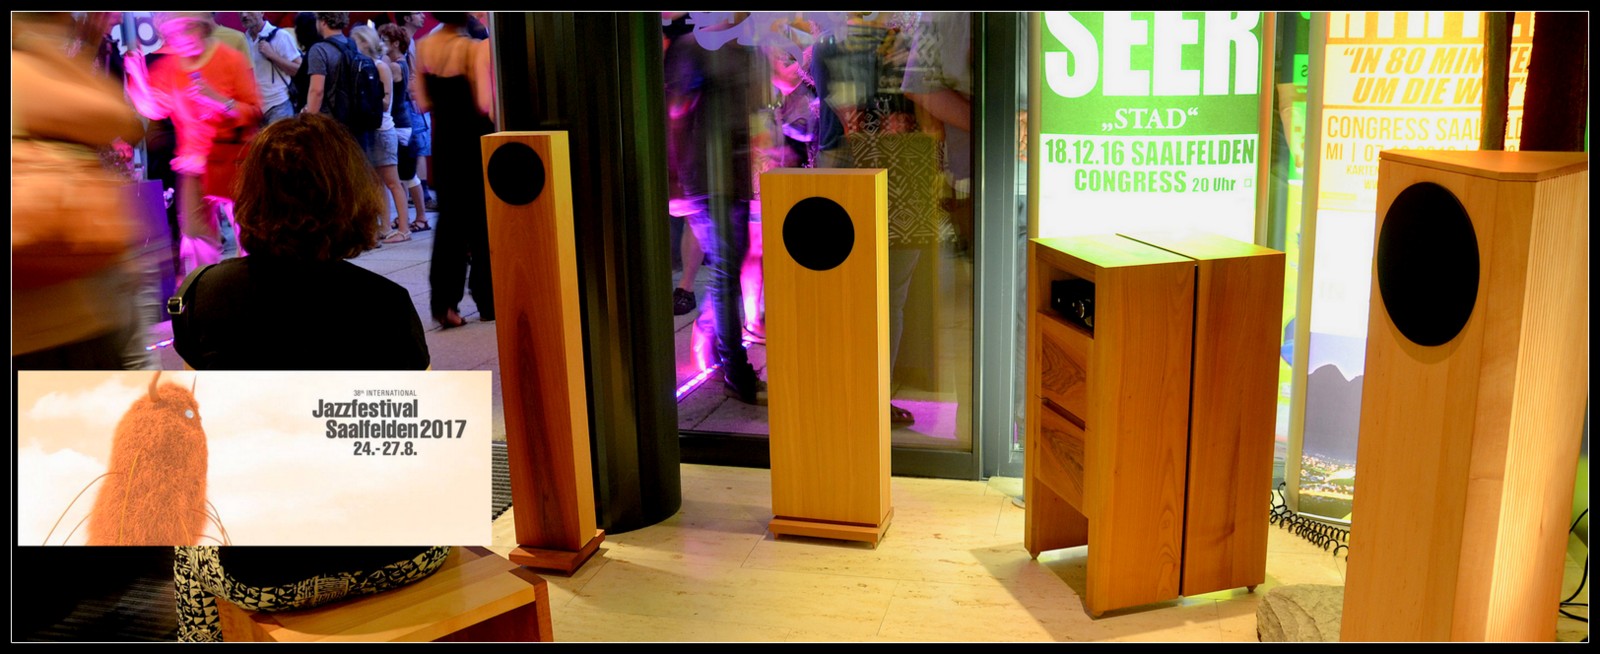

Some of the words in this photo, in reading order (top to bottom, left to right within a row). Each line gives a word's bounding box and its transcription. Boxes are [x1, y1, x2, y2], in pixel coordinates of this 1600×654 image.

[1044, 12, 1260, 98] SEER
[1385, 47, 1426, 75] 80
[1352, 78, 1395, 104] UM
[1401, 77, 1450, 104] DIE
[1327, 115, 1430, 141] CONGRESS
[1045, 139, 1125, 166] 18.12.16
[1131, 139, 1255, 166] SAALFELDEN
[1326, 143, 1343, 160] MI
[1074, 169, 1187, 193] CONGRESS
[1192, 178, 1209, 193] 20
[1213, 177, 1236, 192] Uhr
